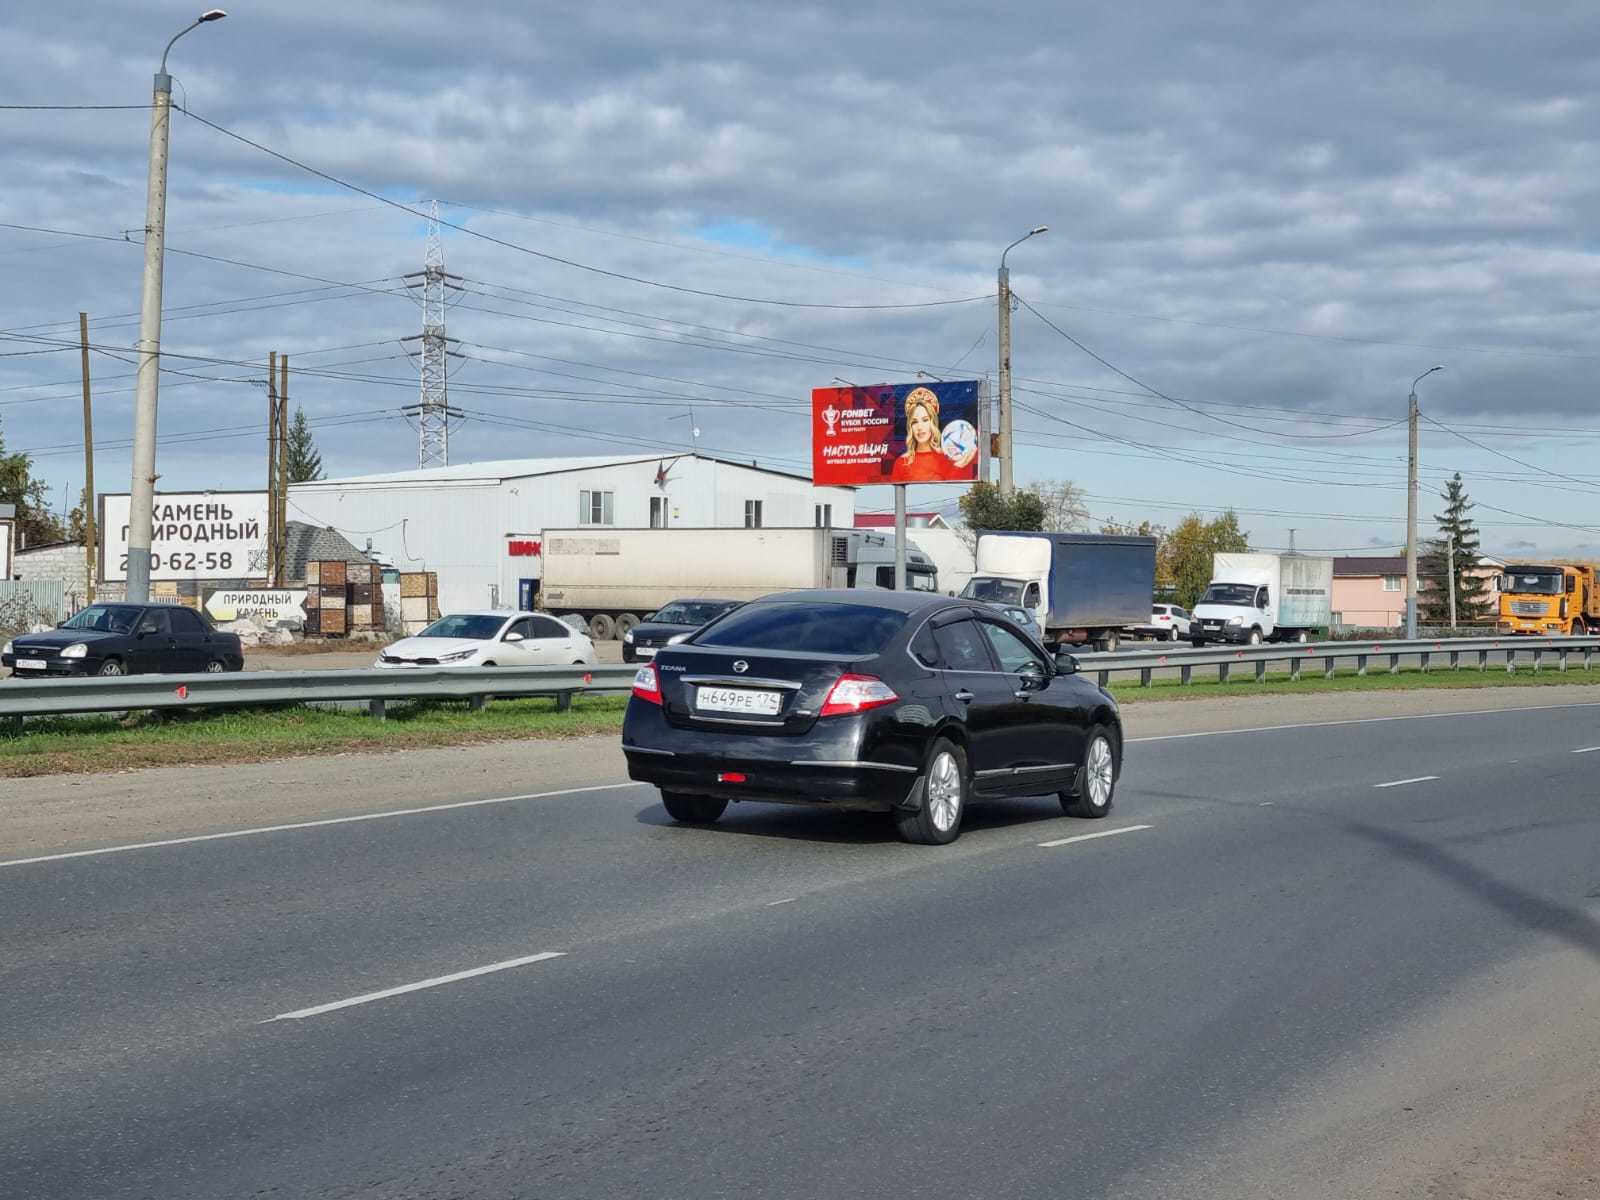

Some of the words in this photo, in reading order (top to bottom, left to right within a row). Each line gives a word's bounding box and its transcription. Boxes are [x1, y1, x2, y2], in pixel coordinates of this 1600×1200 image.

[841, 408, 875, 418] FONBET
[841, 419, 861, 427] КУБОК
[823, 443, 889, 457] НАСТОЯЩИЙ
[121, 518, 259, 543] ПИРОДНЫЙ
[119, 551, 232, 572] 20-62-58
[223, 592, 292, 605] ПРИРОДНЫЙ
